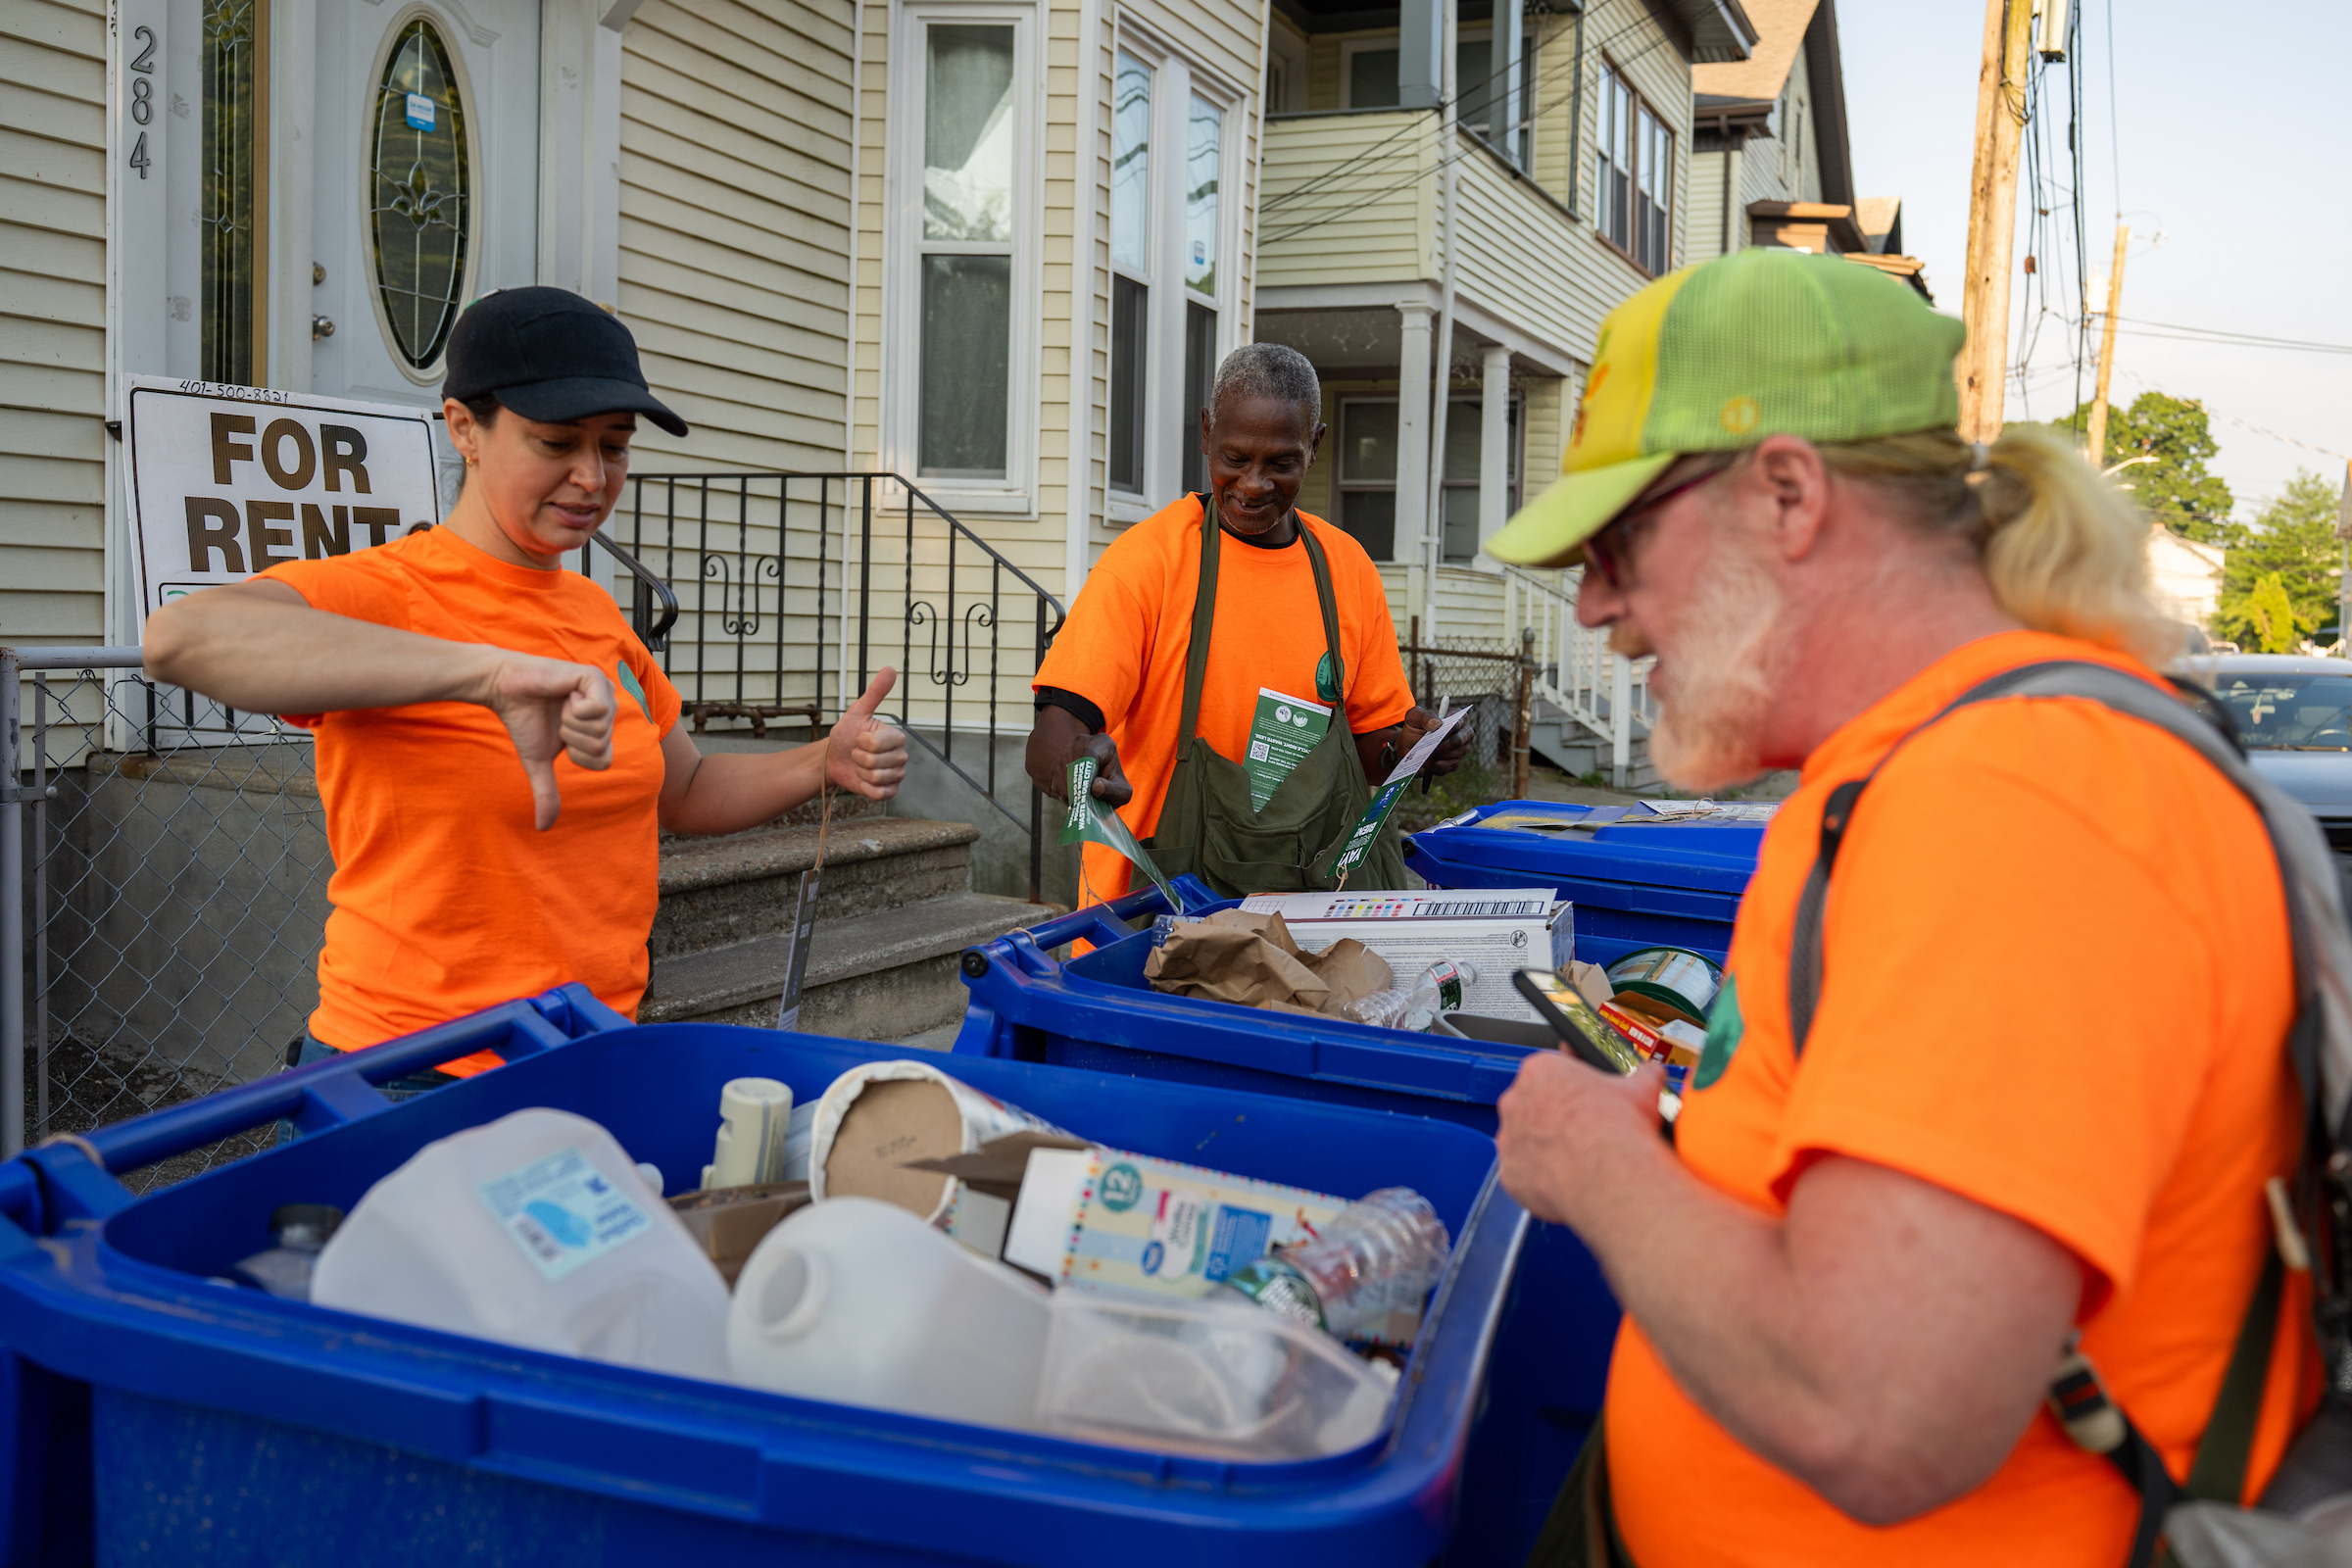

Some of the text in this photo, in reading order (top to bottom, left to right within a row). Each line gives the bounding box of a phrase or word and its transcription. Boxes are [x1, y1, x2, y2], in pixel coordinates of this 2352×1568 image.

[129, 25, 158, 179] 284
[210, 412, 372, 495] FOR
[184, 496, 401, 573] RENT
[1083, 760, 1093, 779] CITY?
[1104, 1169, 1131, 1201] 12
